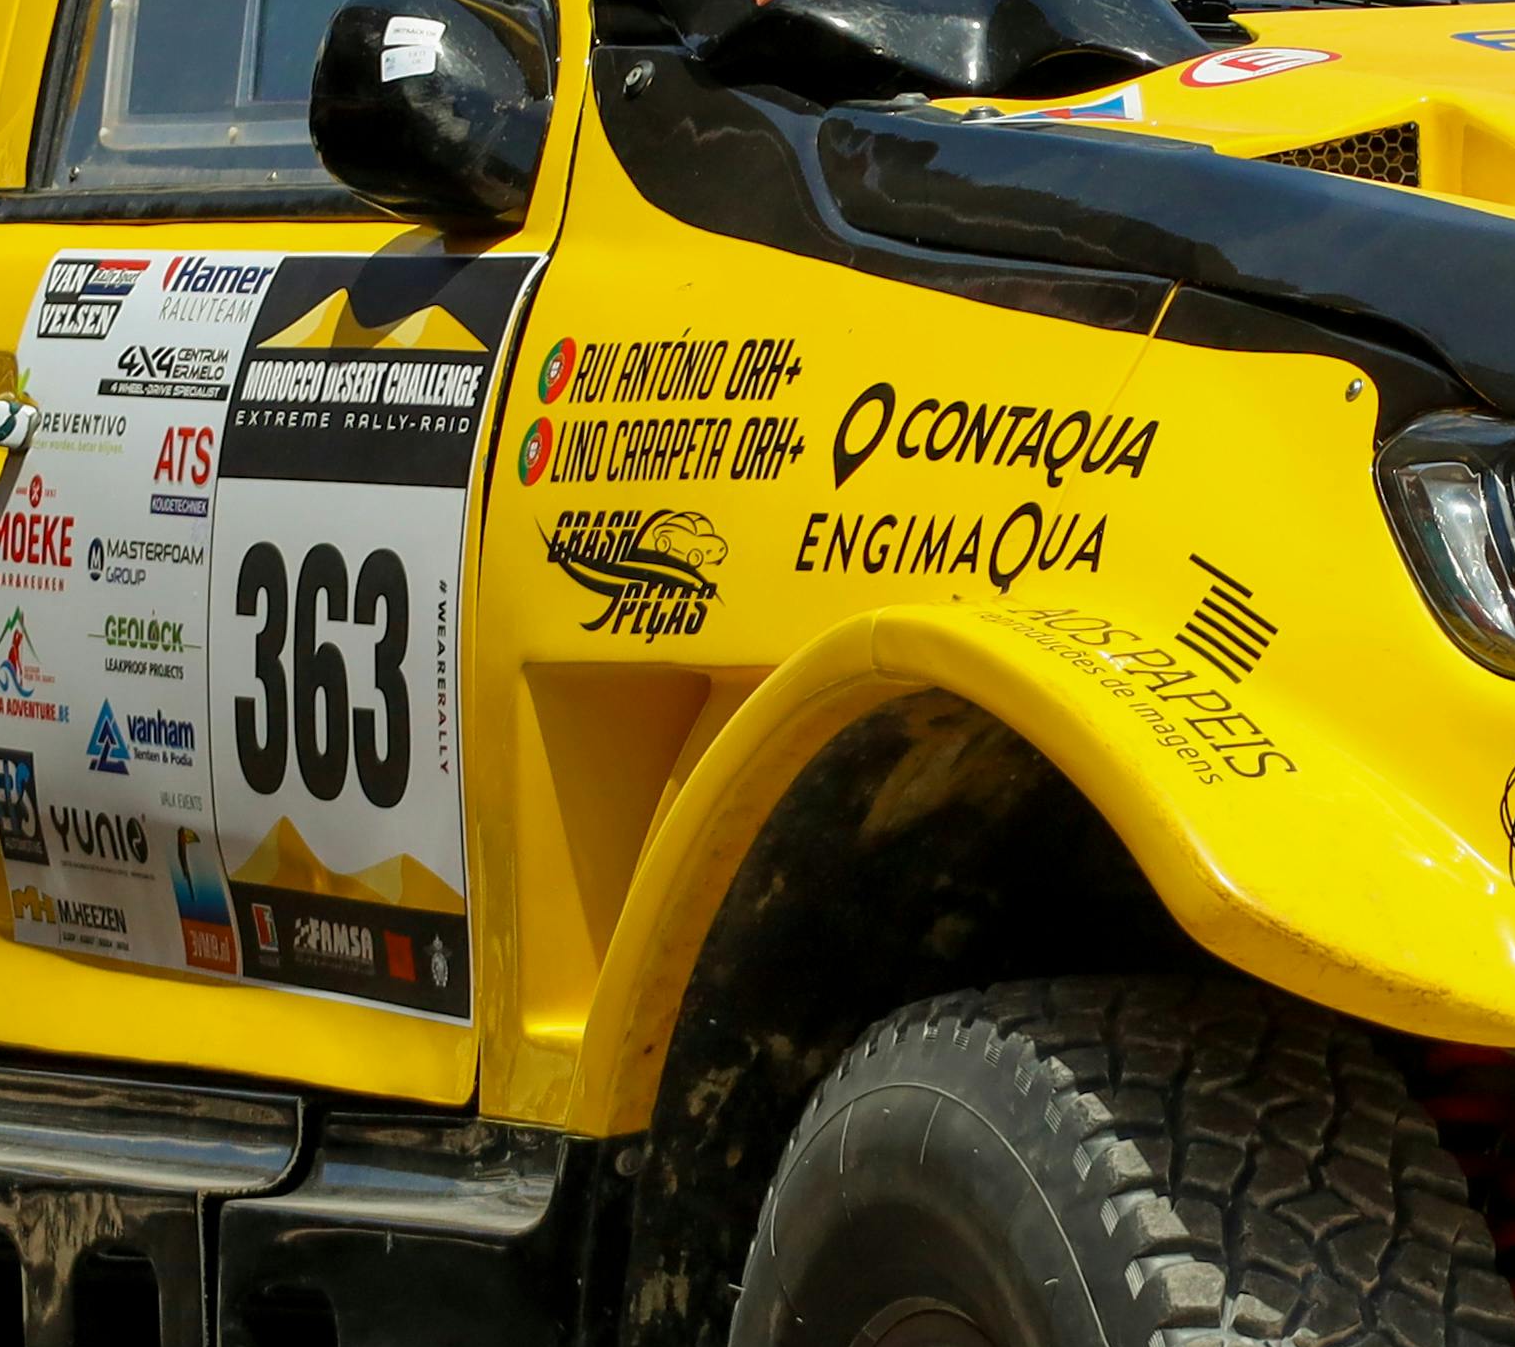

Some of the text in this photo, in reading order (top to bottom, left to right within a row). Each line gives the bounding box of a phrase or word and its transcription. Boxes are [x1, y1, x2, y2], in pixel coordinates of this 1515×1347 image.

[47, 263, 90, 295] VAN
[171, 256, 275, 294] Hamer
[38, 303, 119, 337] VELSEN
[159, 296, 254, 324] RALLYTEAM
[172, 365, 224, 381] ERMELO
[176, 348, 229, 363] CENTRUM
[569, 327, 802, 404] RUI ANTÓNIO ORH+
[172, 384, 221, 399] SPECIALIST
[240, 360, 485, 408] MOROCCO DESERT CHALLENGE
[42, 412, 127, 437] REVENTIVO
[236, 410, 472, 434] EXTREME RALLY-RAID
[153, 425, 215, 487] ATS
[550, 417, 805, 483] LINO CARAPETA ORH+
[895, 398, 1160, 488] CONTAQUA
[106, 538, 204, 566] MASTERFOAM
[549, 510, 643, 563] CRASH
[794, 501, 1108, 595] ENGIMAQUA
[105, 566, 147, 586] GROUP
[610, 582, 718, 643] PEÇAS
[104, 615, 184, 653] GEOLOCK
[104, 657, 184, 680] LEAKPROOF PROJECTS
[235, 541, 411, 809] 363
[1100, 677, 1134, 699] de
[126, 709, 196, 751] vanham
[1109, 647, 1298, 779] PAPEIS
[177, 794, 204, 813] EVENTS
[57, 899, 128, 935] M.HEEZEN
